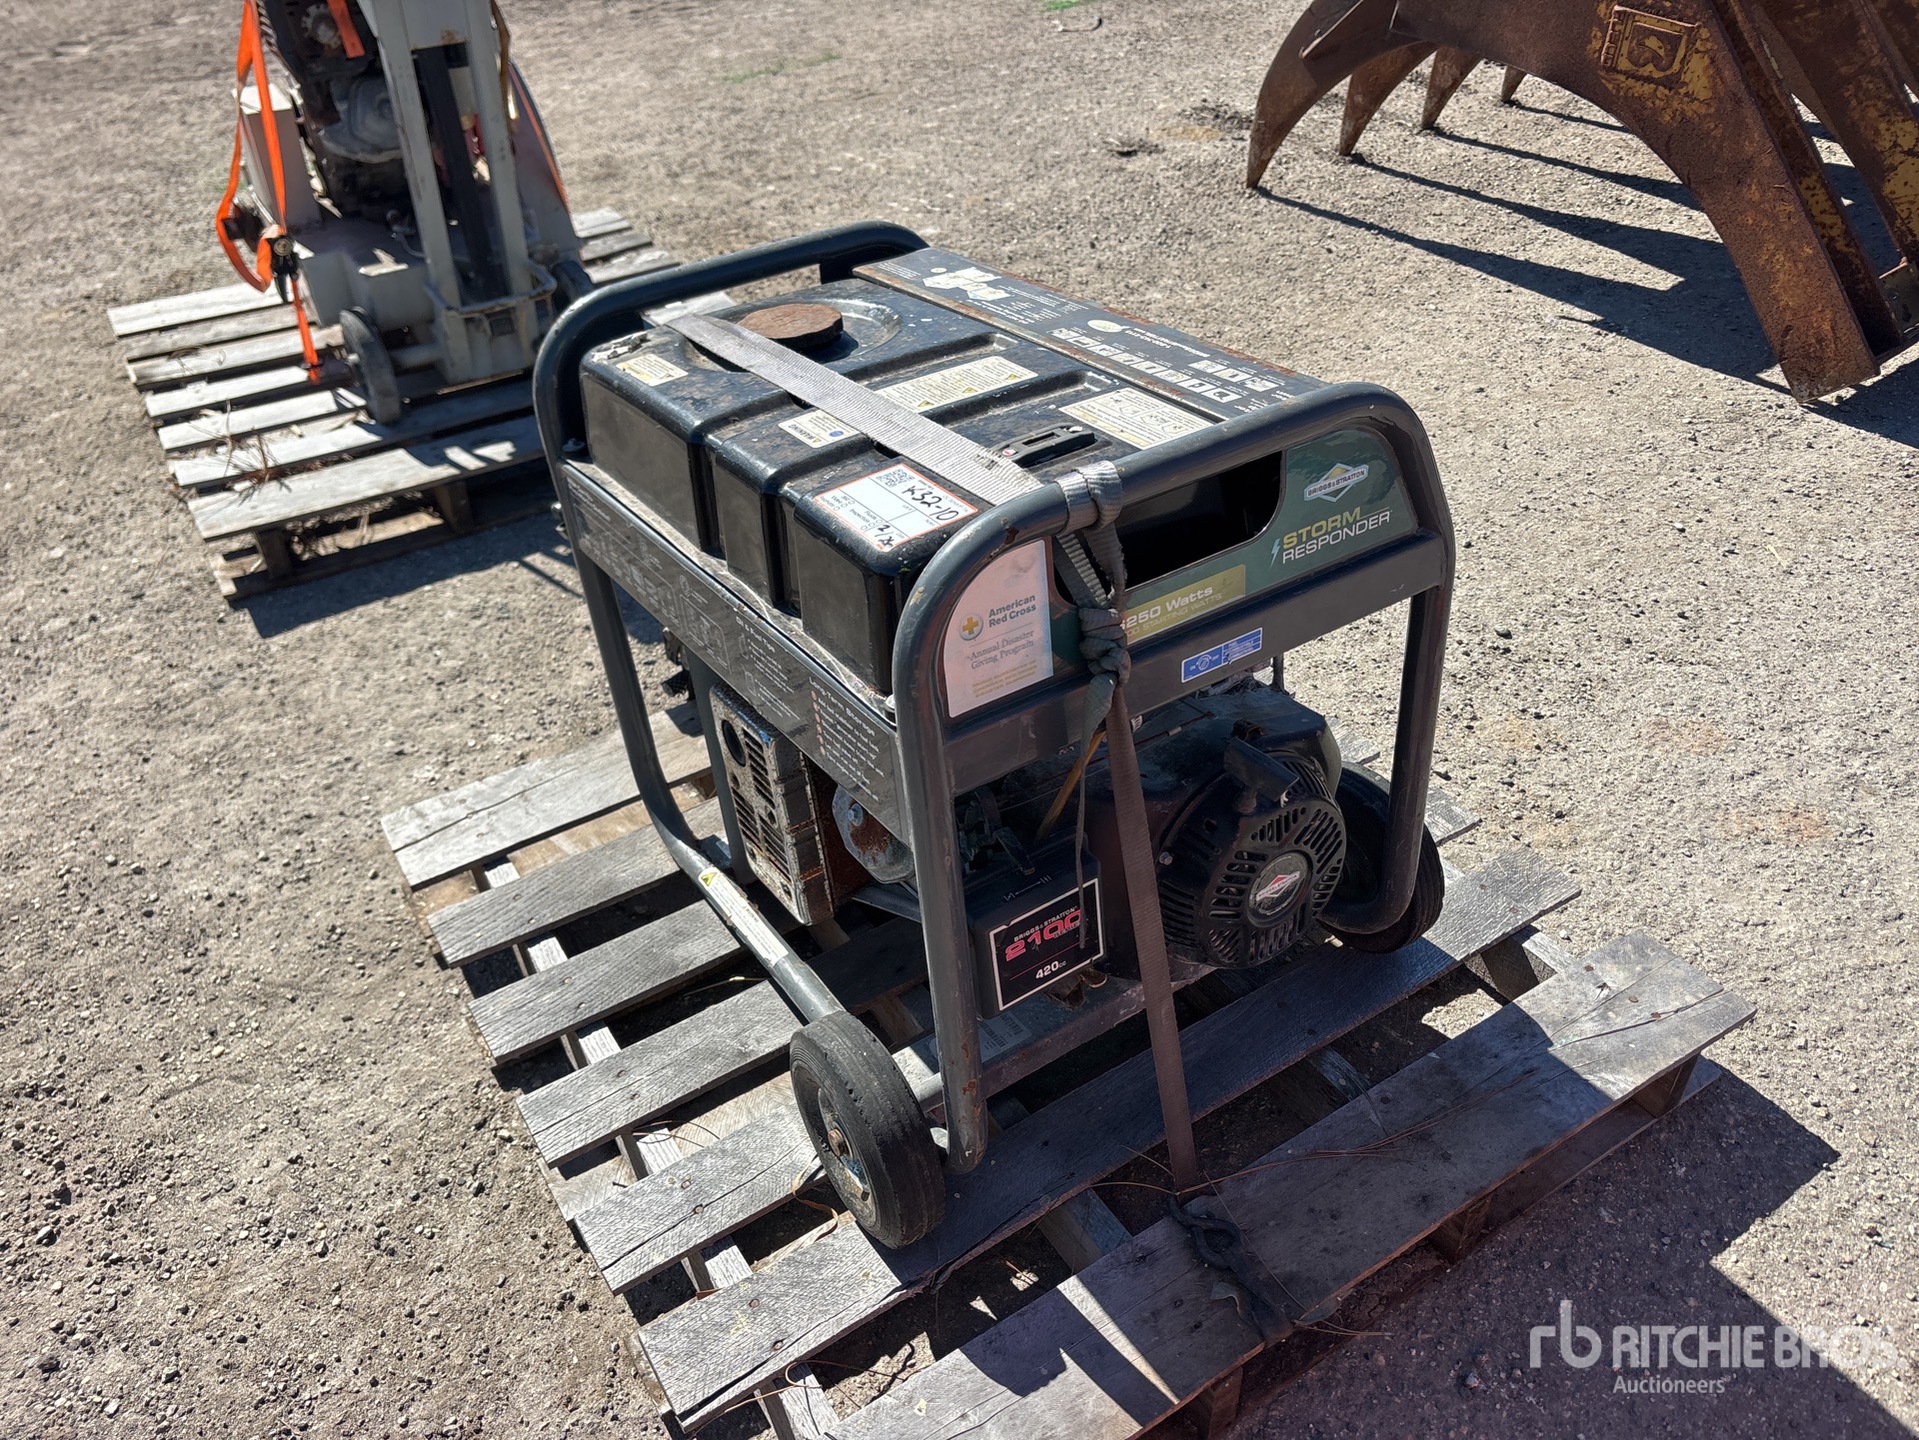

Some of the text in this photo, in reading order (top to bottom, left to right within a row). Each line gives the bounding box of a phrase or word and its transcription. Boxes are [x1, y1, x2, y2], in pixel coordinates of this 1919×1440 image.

[1282, 506, 1362, 550] STORM
[1282, 511, 1391, 565] RESPONDER
[988, 594, 1036, 619] American
[988, 604, 1037, 628] Red Cross
[1120, 586, 1213, 631] 250 Watts
[1142, 606, 1189, 632] STARTING
[1189, 592, 1223, 612] WATTS
[969, 630, 1035, 661] Annual Disaster
[971, 640, 1035, 670] Giving Program
[1005, 909, 1082, 962] 2100
